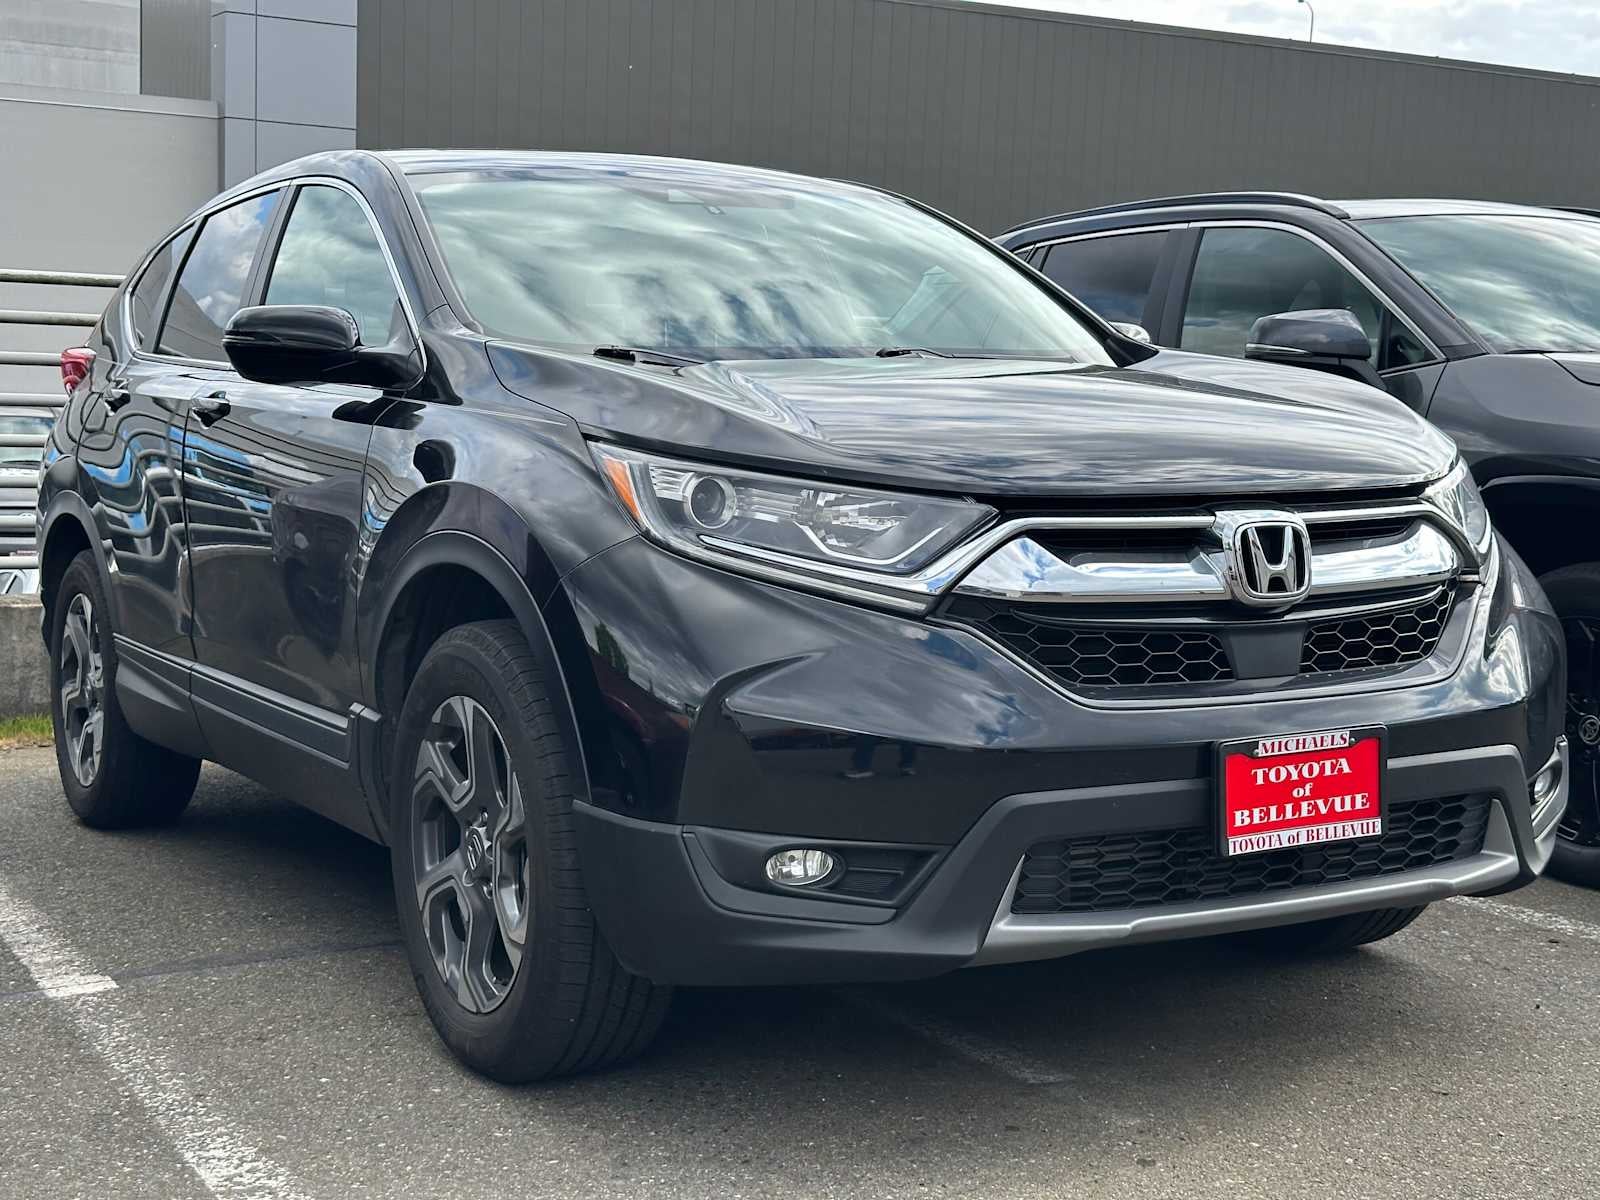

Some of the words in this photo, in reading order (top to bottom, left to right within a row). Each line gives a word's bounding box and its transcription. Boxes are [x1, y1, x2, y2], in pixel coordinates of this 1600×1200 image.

[1251, 757, 1352, 785] TOYOTA
[1292, 782, 1313, 798] of
[1233, 792, 1370, 827] BELLEVUE
[1230, 836, 1283, 854] TOYOTA
[1287, 833, 1300, 845] of
[1306, 821, 1380, 842] BELLEVUE
